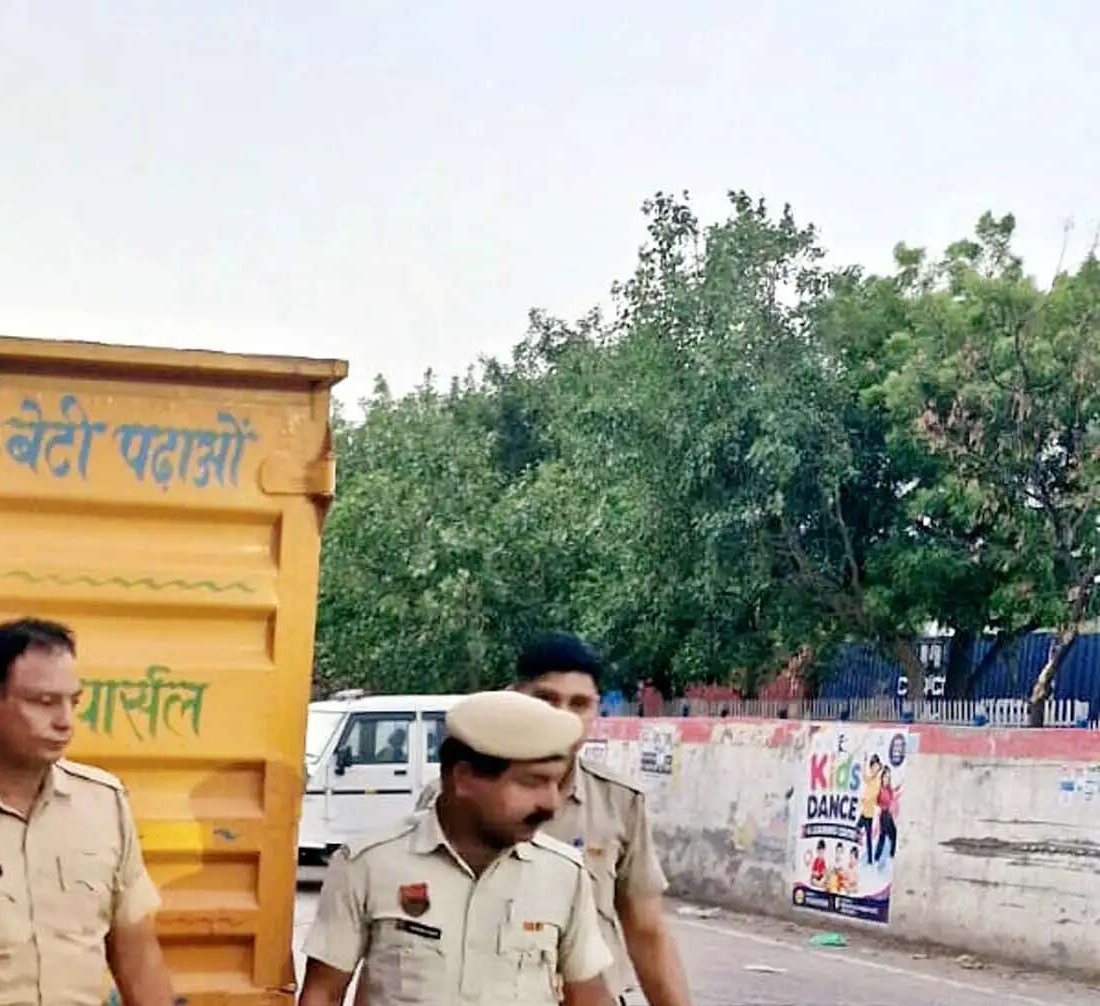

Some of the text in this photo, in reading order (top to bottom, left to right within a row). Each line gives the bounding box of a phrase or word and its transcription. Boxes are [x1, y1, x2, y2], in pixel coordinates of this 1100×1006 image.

[5, 395, 106, 480] बेटी
[811, 753, 860, 791] Kids
[807, 795, 858, 820] DANCE
